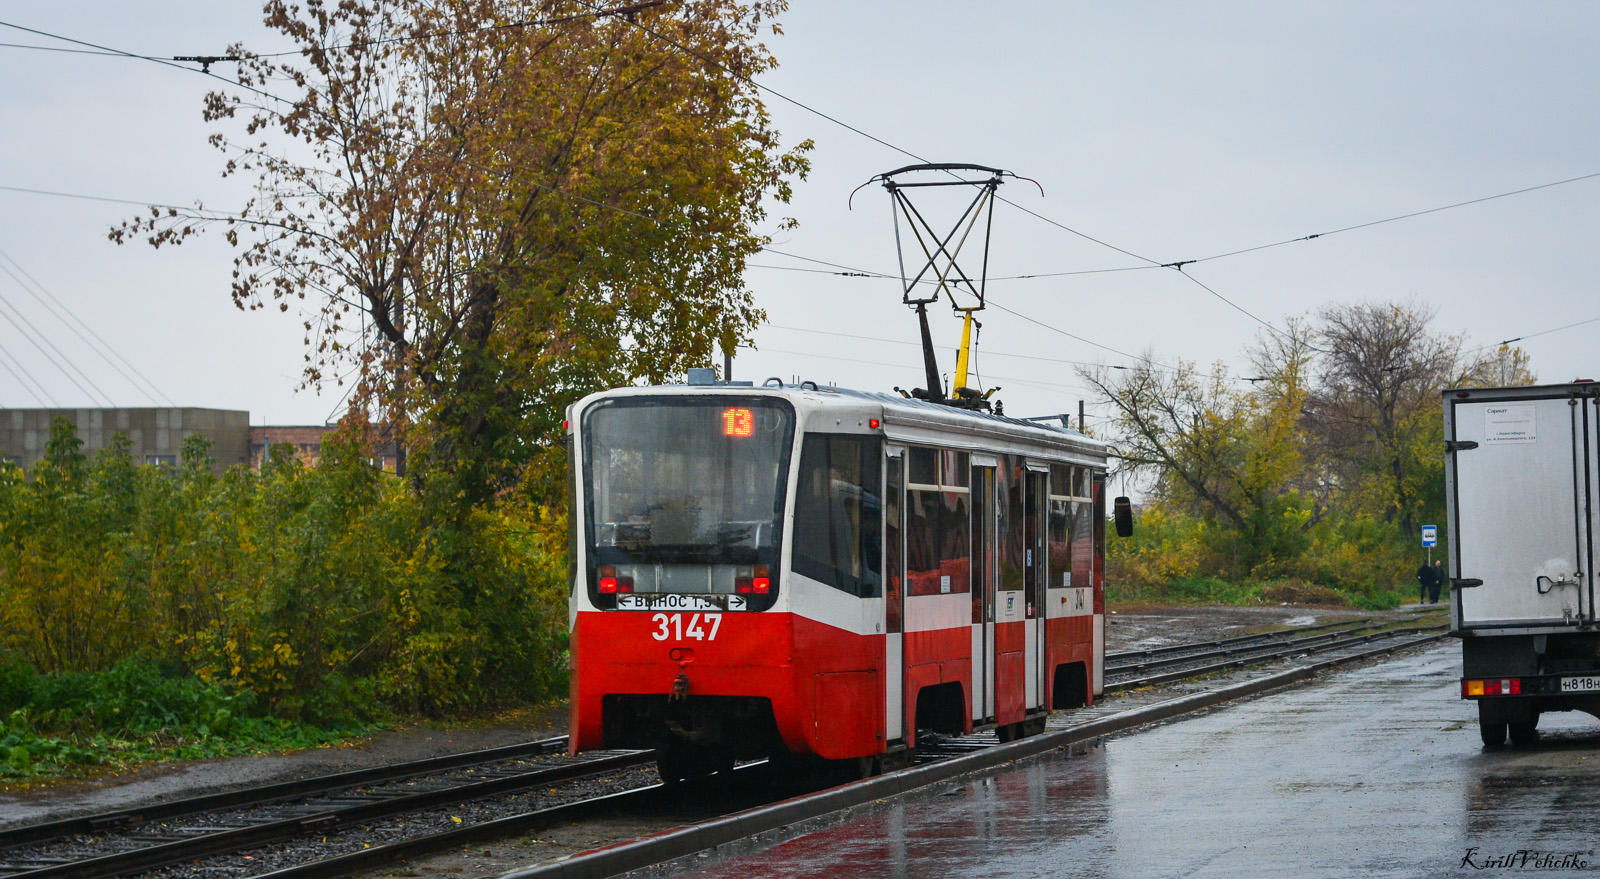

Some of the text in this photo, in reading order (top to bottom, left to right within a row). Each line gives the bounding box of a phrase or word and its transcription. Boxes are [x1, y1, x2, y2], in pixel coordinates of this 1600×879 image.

[723, 408, 752, 436] 13
[635, 595, 687, 608] ВЫНОС
[651, 613, 722, 641] 3147
